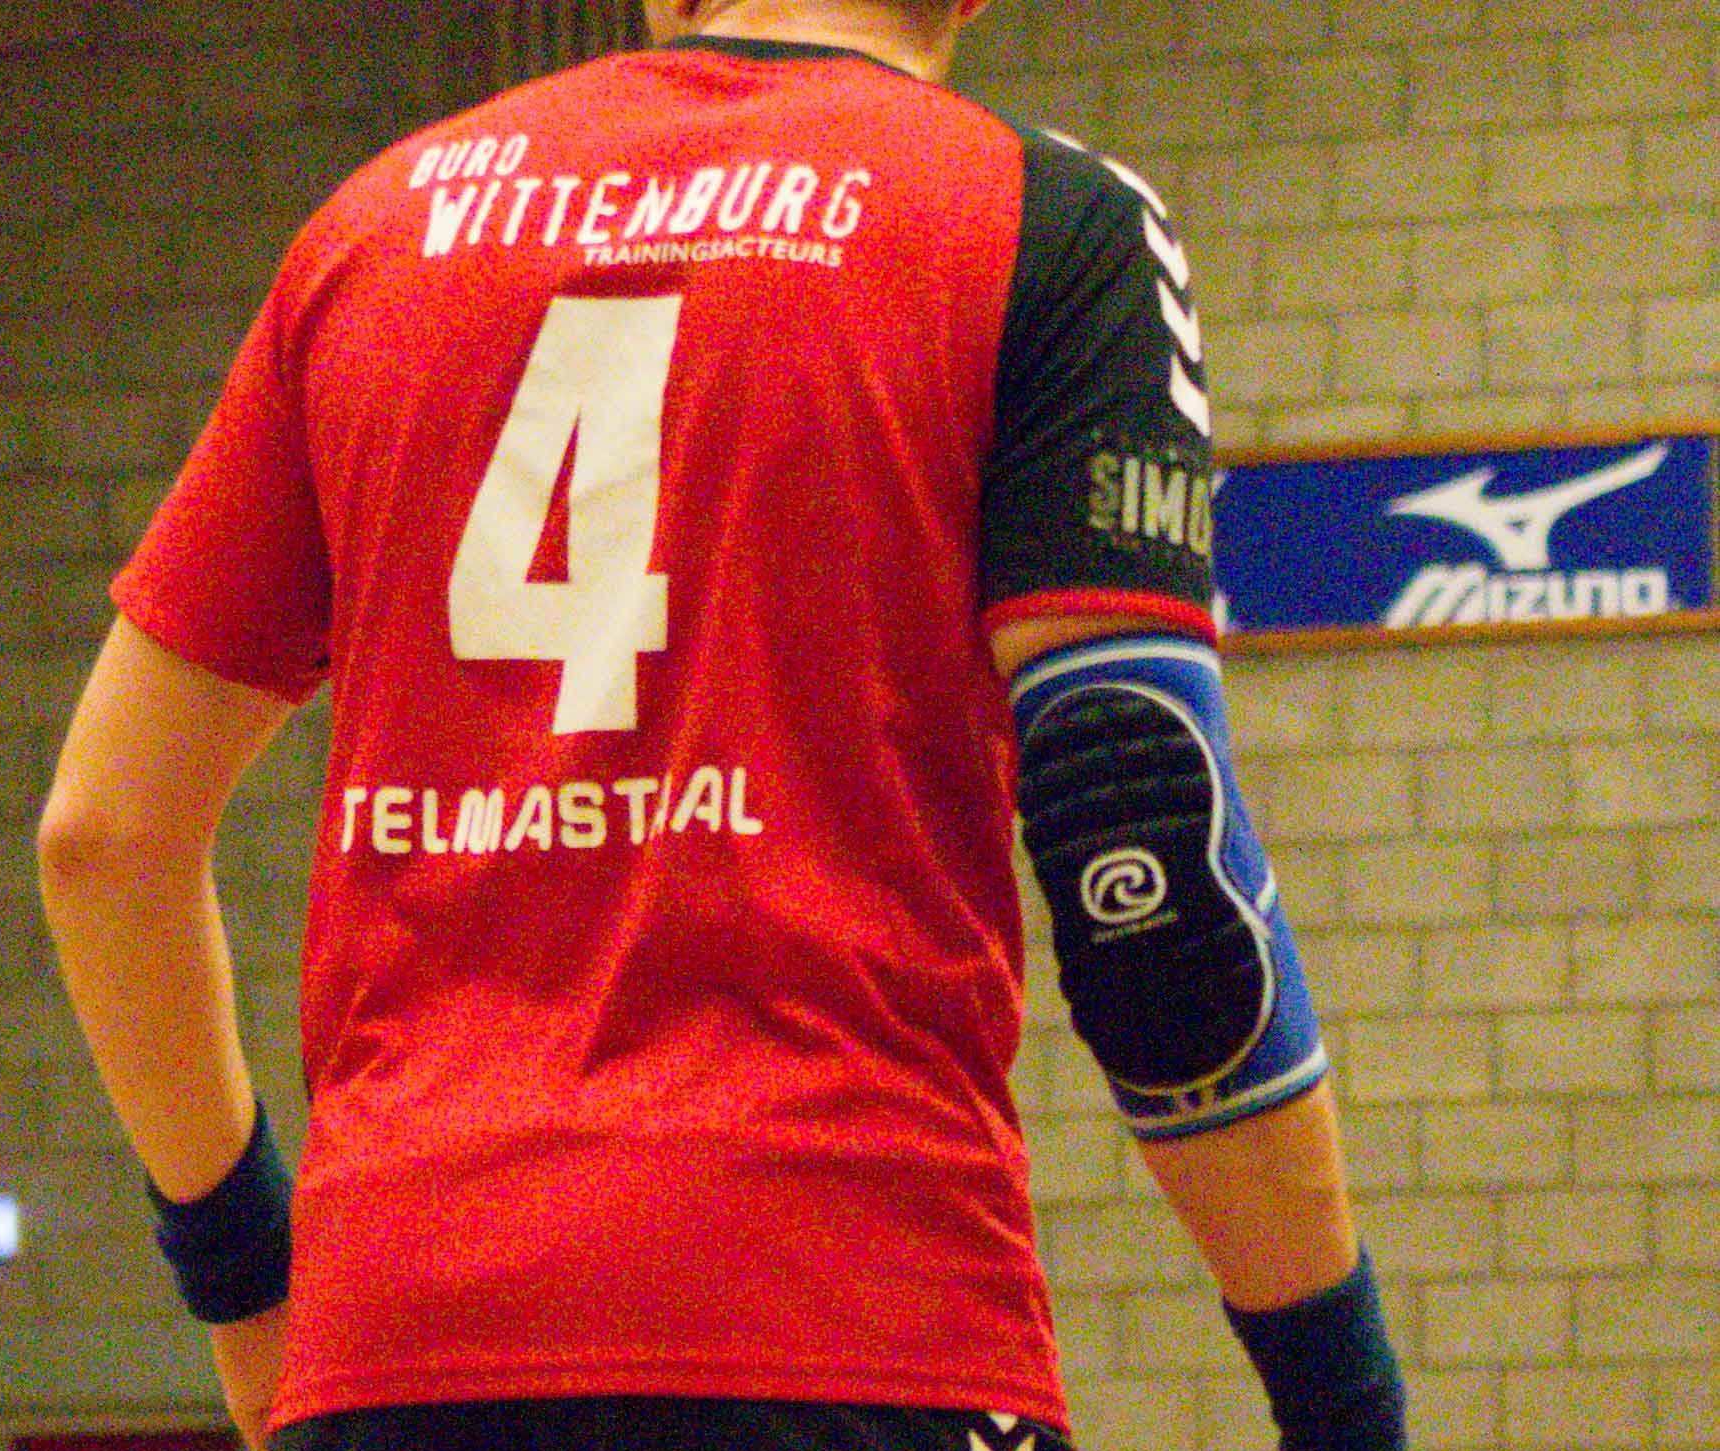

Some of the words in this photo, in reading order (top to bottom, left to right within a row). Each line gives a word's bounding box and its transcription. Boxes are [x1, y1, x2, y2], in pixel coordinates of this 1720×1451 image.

[408, 133, 529, 189] BURO
[422, 162, 872, 258] WITTENBURG
[583, 236, 845, 268] TRAININGSACTEURS
[448, 293, 684, 736] 4
